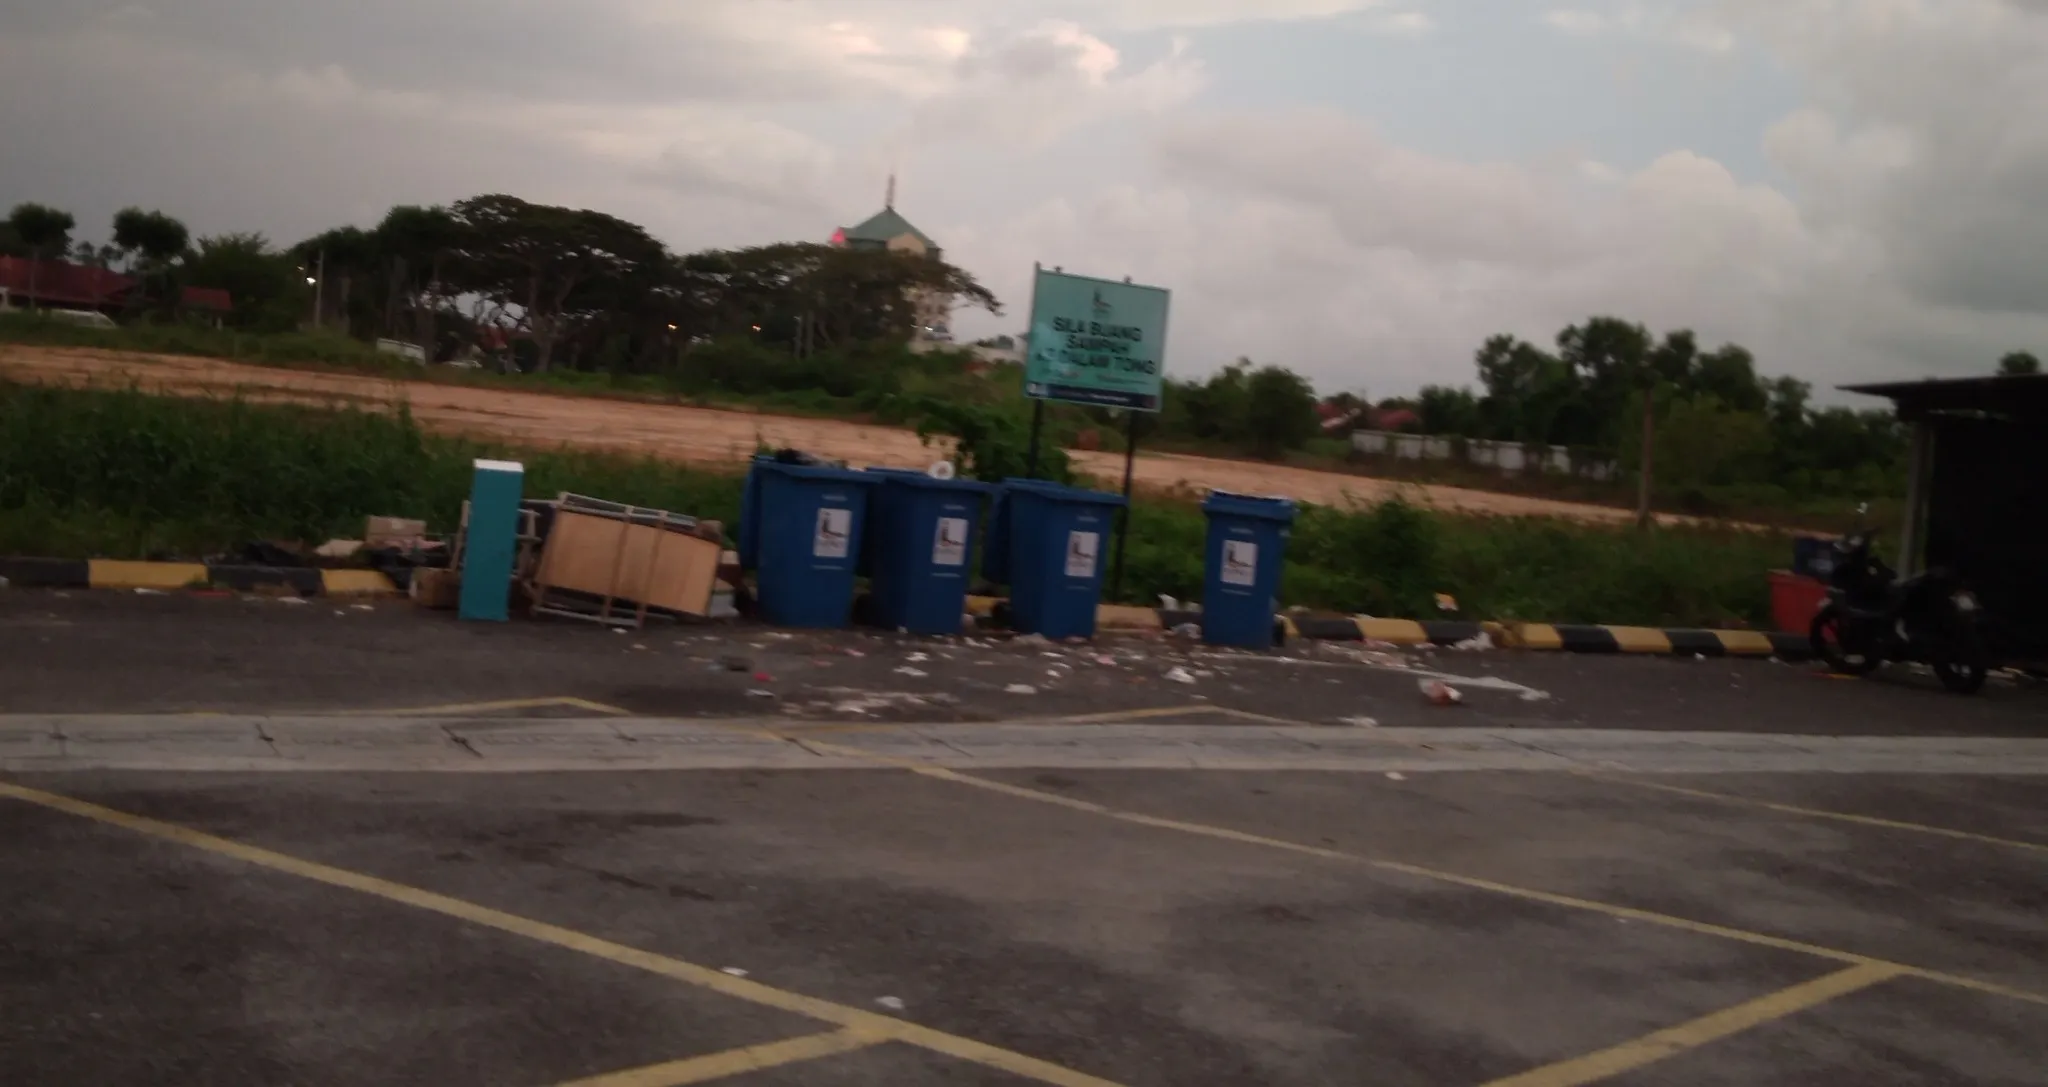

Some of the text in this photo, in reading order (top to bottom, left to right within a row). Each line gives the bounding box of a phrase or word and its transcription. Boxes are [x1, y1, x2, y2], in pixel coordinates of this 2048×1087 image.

[1053, 316, 1142, 341] SILA BUANG
[1066, 334, 1130, 354] SAMPAH
[1113, 356, 1156, 375] TONG
